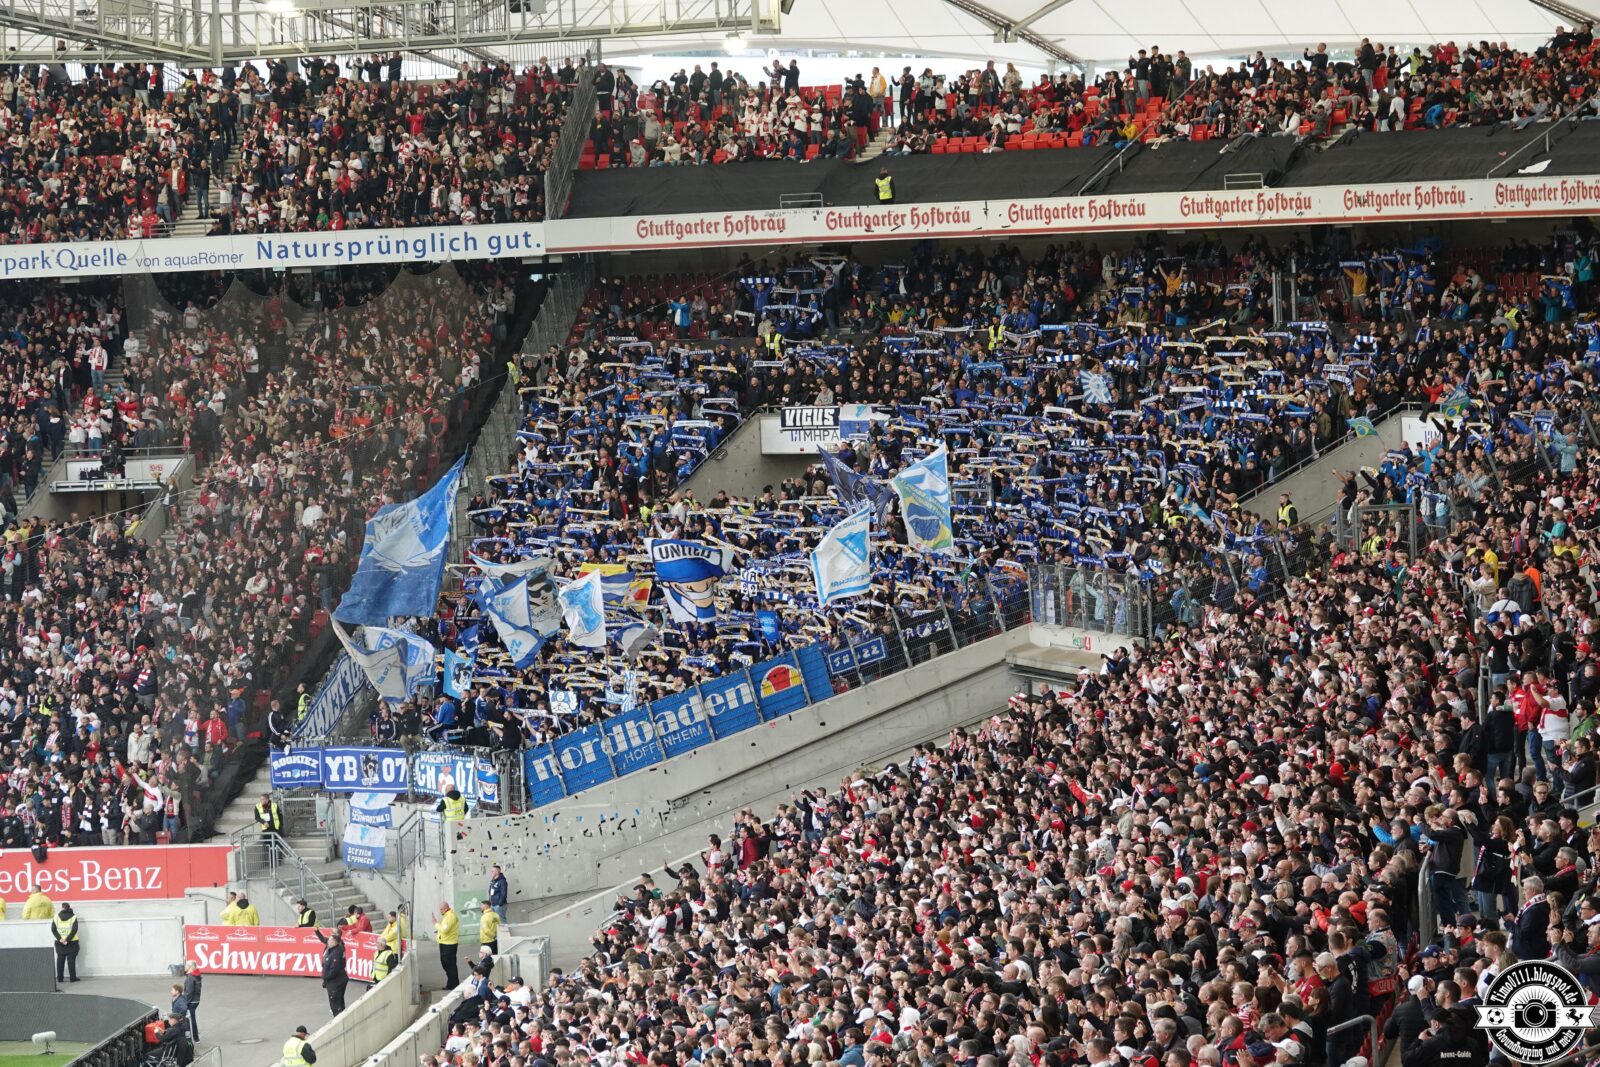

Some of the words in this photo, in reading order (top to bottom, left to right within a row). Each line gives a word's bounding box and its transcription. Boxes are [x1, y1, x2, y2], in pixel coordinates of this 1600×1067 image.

[1180, 193, 1253, 219] Stuttgarter
[1257, 191, 1313, 215] Hofbräu
[1343, 189, 1412, 213] Stuttgarter
[1414, 185, 1466, 210] Hofbräu
[1495, 183, 1558, 208] Stuttgarter
[1561, 179, 1600, 206] Hofbrä
[826, 209, 907, 232] Stuttgarter
[910, 205, 971, 227] Hofbräu
[1008, 201, 1085, 226] Stuttgarter
[1088, 198, 1146, 223] Hofbräu
[636, 218, 720, 240] Stuttgarter
[56, 247, 127, 271] Quelle
[256, 231, 478, 262] Natursprünglich
[487, 230, 542, 256] gut.
[136, 257, 160, 268] von
[164, 252, 244, 269] aquaRömer
[532, 681, 754, 781] nordbaden
[624, 726, 704, 764] HOFFENHEIM
[325, 755, 358, 782] YB
[382, 756, 407, 783] 07
[455, 760, 475, 794] 07
